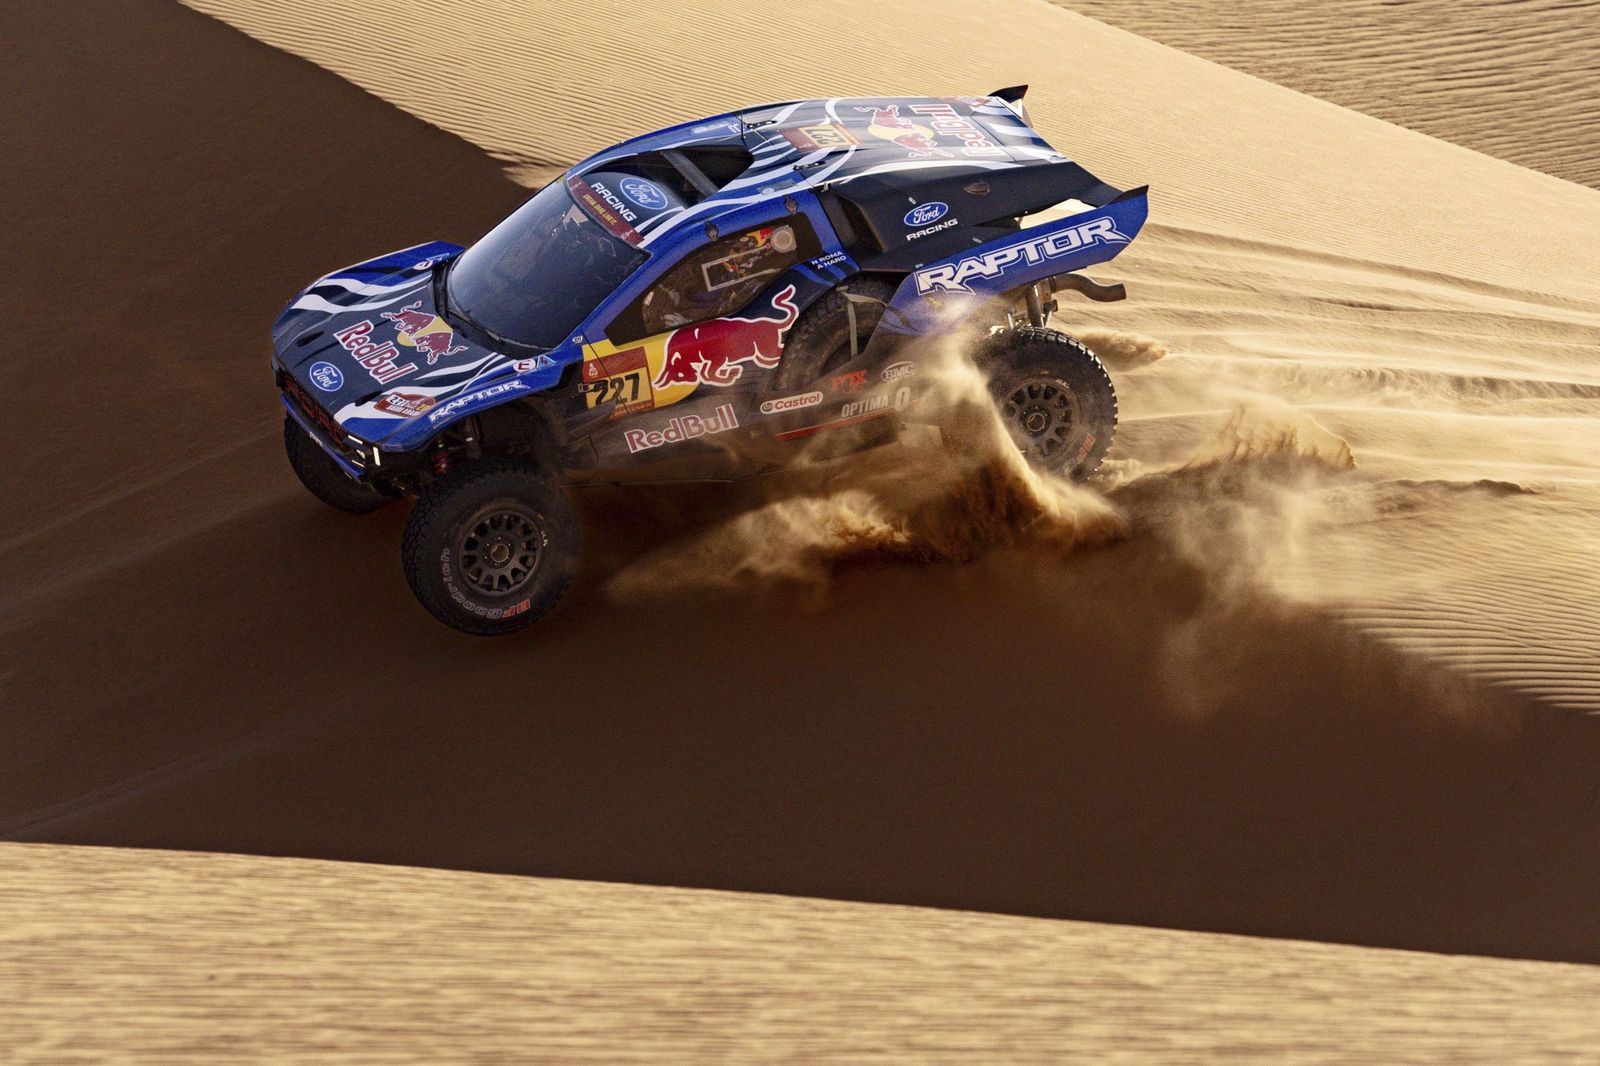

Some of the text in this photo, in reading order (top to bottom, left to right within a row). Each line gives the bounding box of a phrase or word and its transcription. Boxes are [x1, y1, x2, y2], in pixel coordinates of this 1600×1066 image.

[803, 128, 846, 145] 227
[590, 181, 638, 222] RACING
[624, 183, 660, 204] Ford
[912, 205, 941, 224] Ford
[905, 218, 958, 242] RACING
[818, 250, 844, 263] ROMA
[822, 255, 847, 268] HARO
[914, 215, 1134, 296] RAPTOR
[313, 366, 338, 388] Ford
[594, 372, 640, 406] 227
[428, 378, 532, 424] RAPTOR
[774, 392, 821, 410] Castrol
[841, 393, 889, 418] OPTIMA
